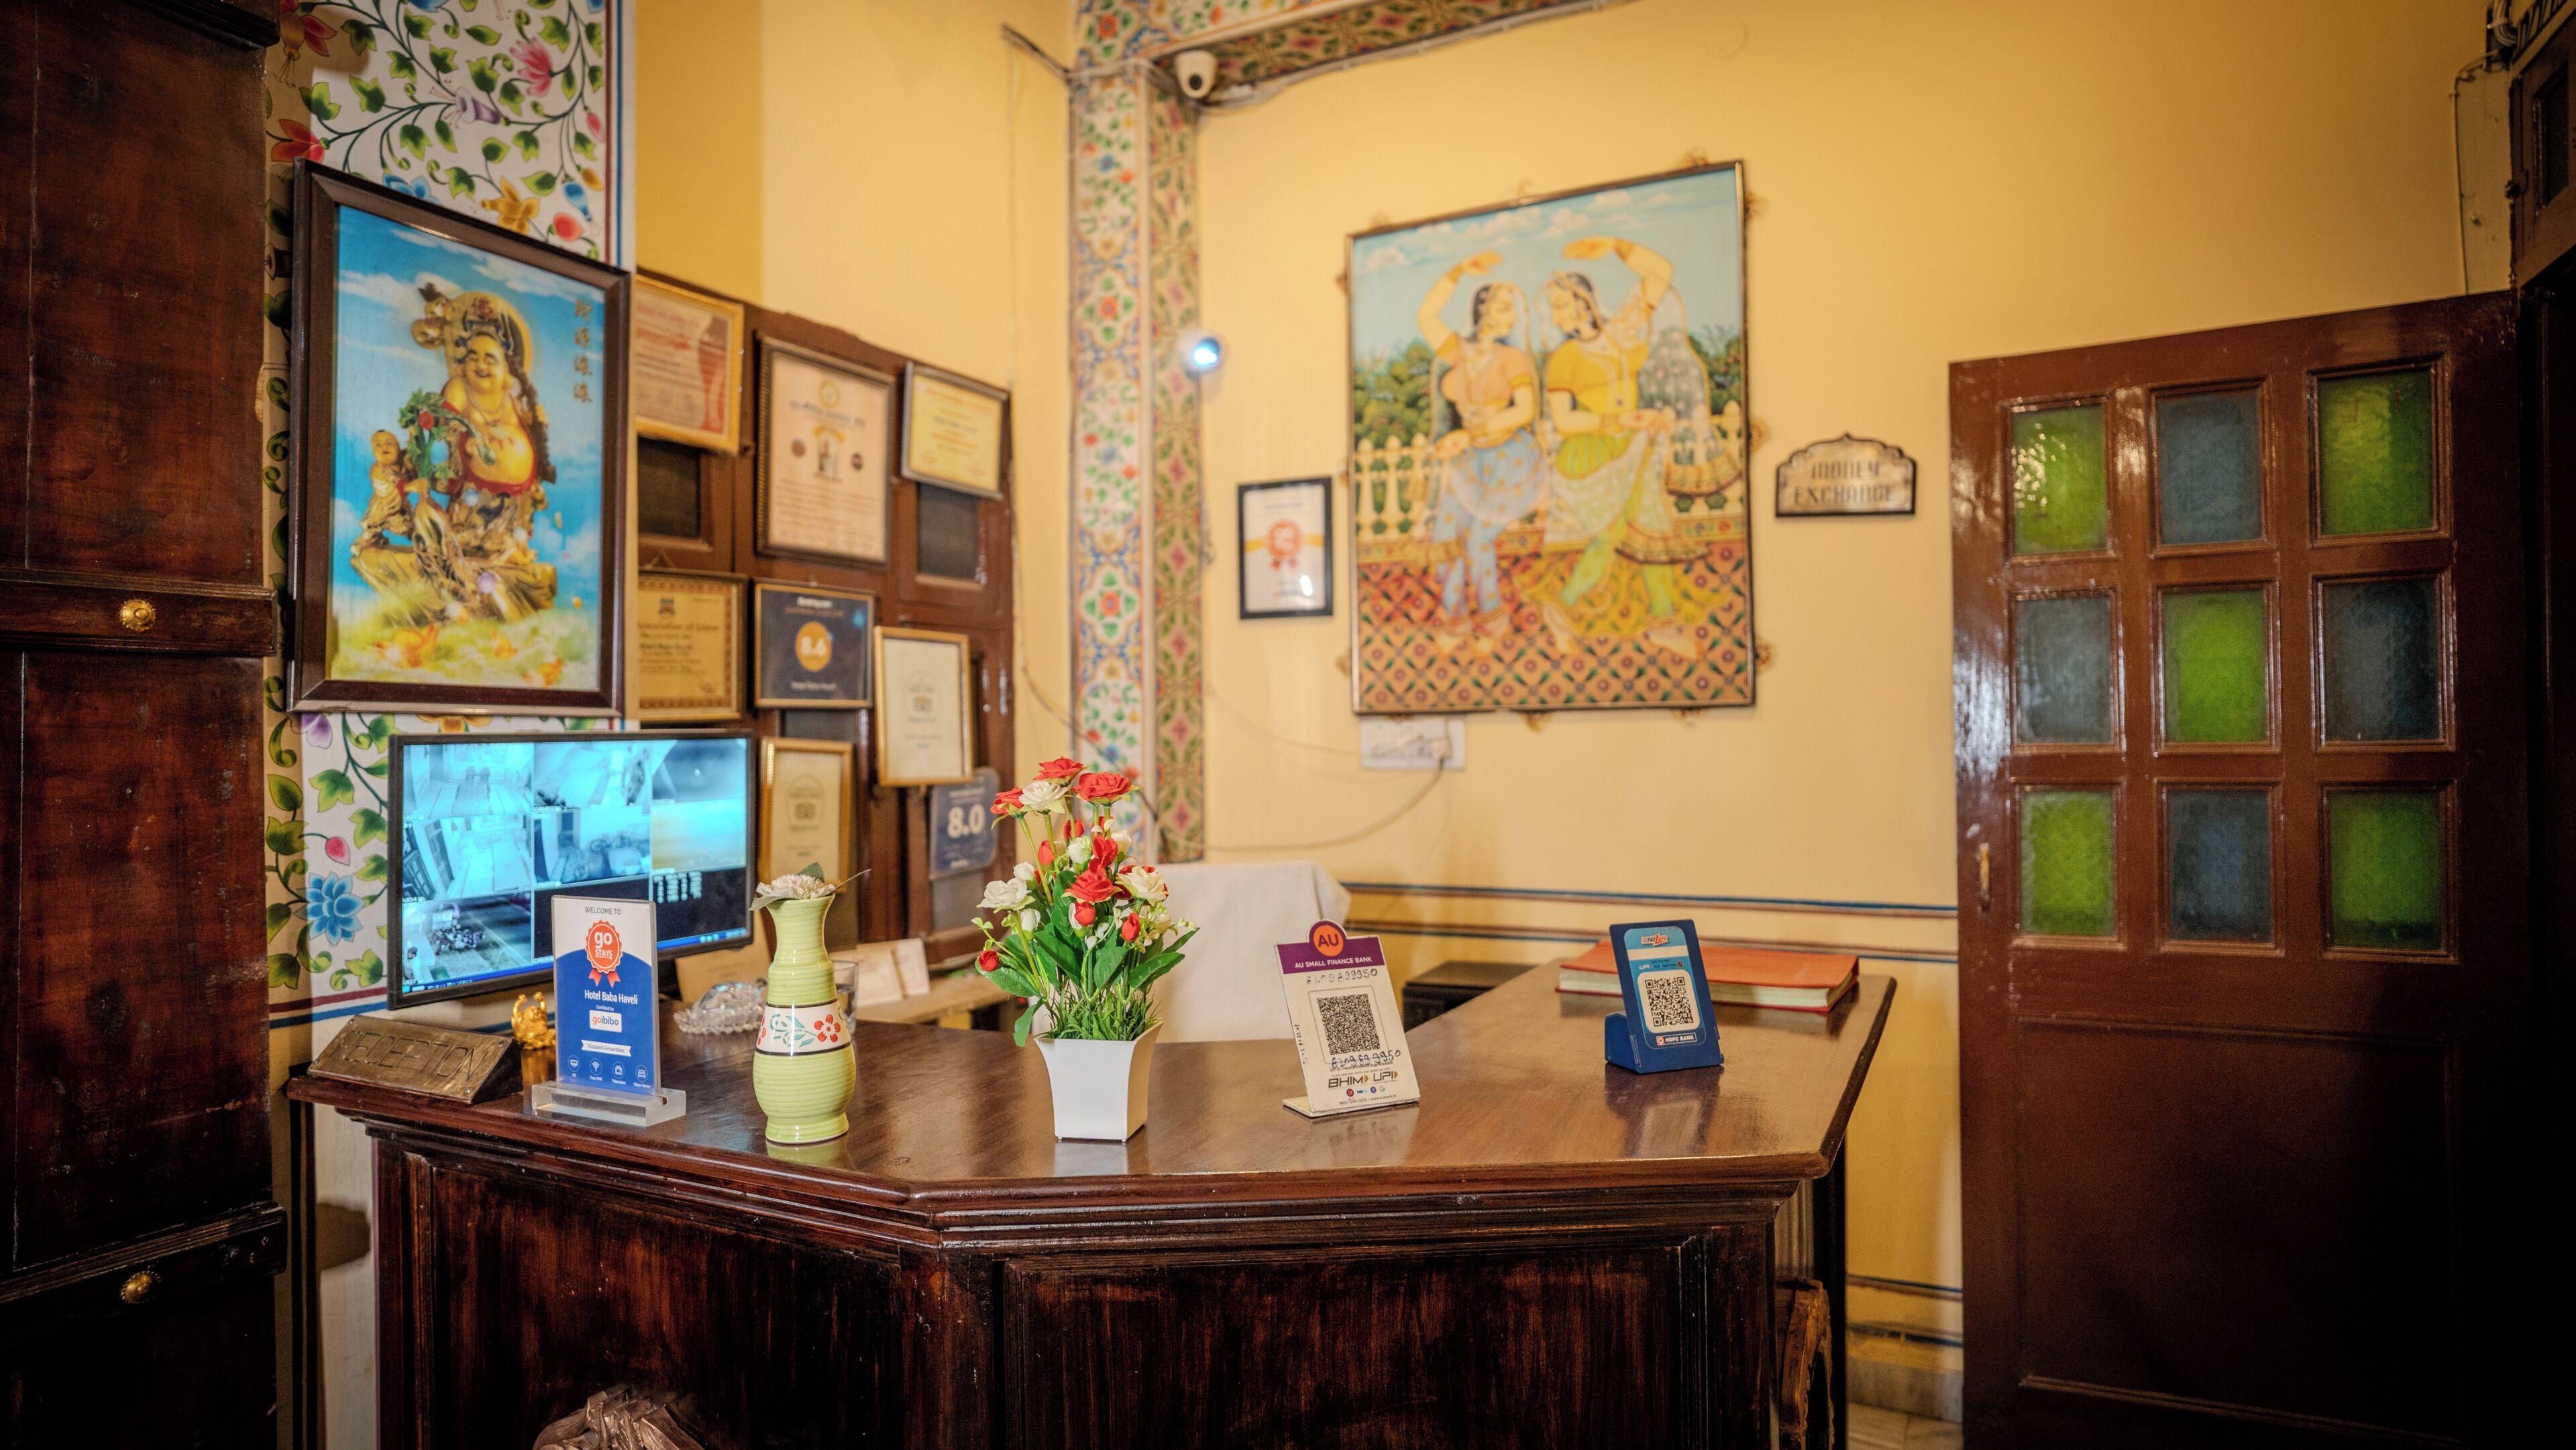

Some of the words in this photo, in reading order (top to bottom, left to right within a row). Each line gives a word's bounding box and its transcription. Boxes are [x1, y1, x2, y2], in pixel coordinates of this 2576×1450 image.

[1811, 459, 1879, 479] MONEY
[1794, 484, 1894, 503] EXCHANGE
[800, 635, 827, 657] 8.6
[947, 804, 985, 838] 8.0
[594, 931, 612, 949] go
[1318, 933, 1339, 947] AU
[595, 949, 612, 957] STAYS
[1327, 957, 1354, 966] FINANCE
[584, 990, 601, 1000] Hotel
[602, 992, 617, 1002] Baba
[619, 994, 638, 1004] Haveli
[592, 1016, 619, 1025] goibibo
[328, 1030, 489, 1081] RECEPTION
[604, 1045, 625, 1053] Amenities
[1328, 1076, 1363, 1088] BHIM
[1373, 1071, 1393, 1082] UPI
